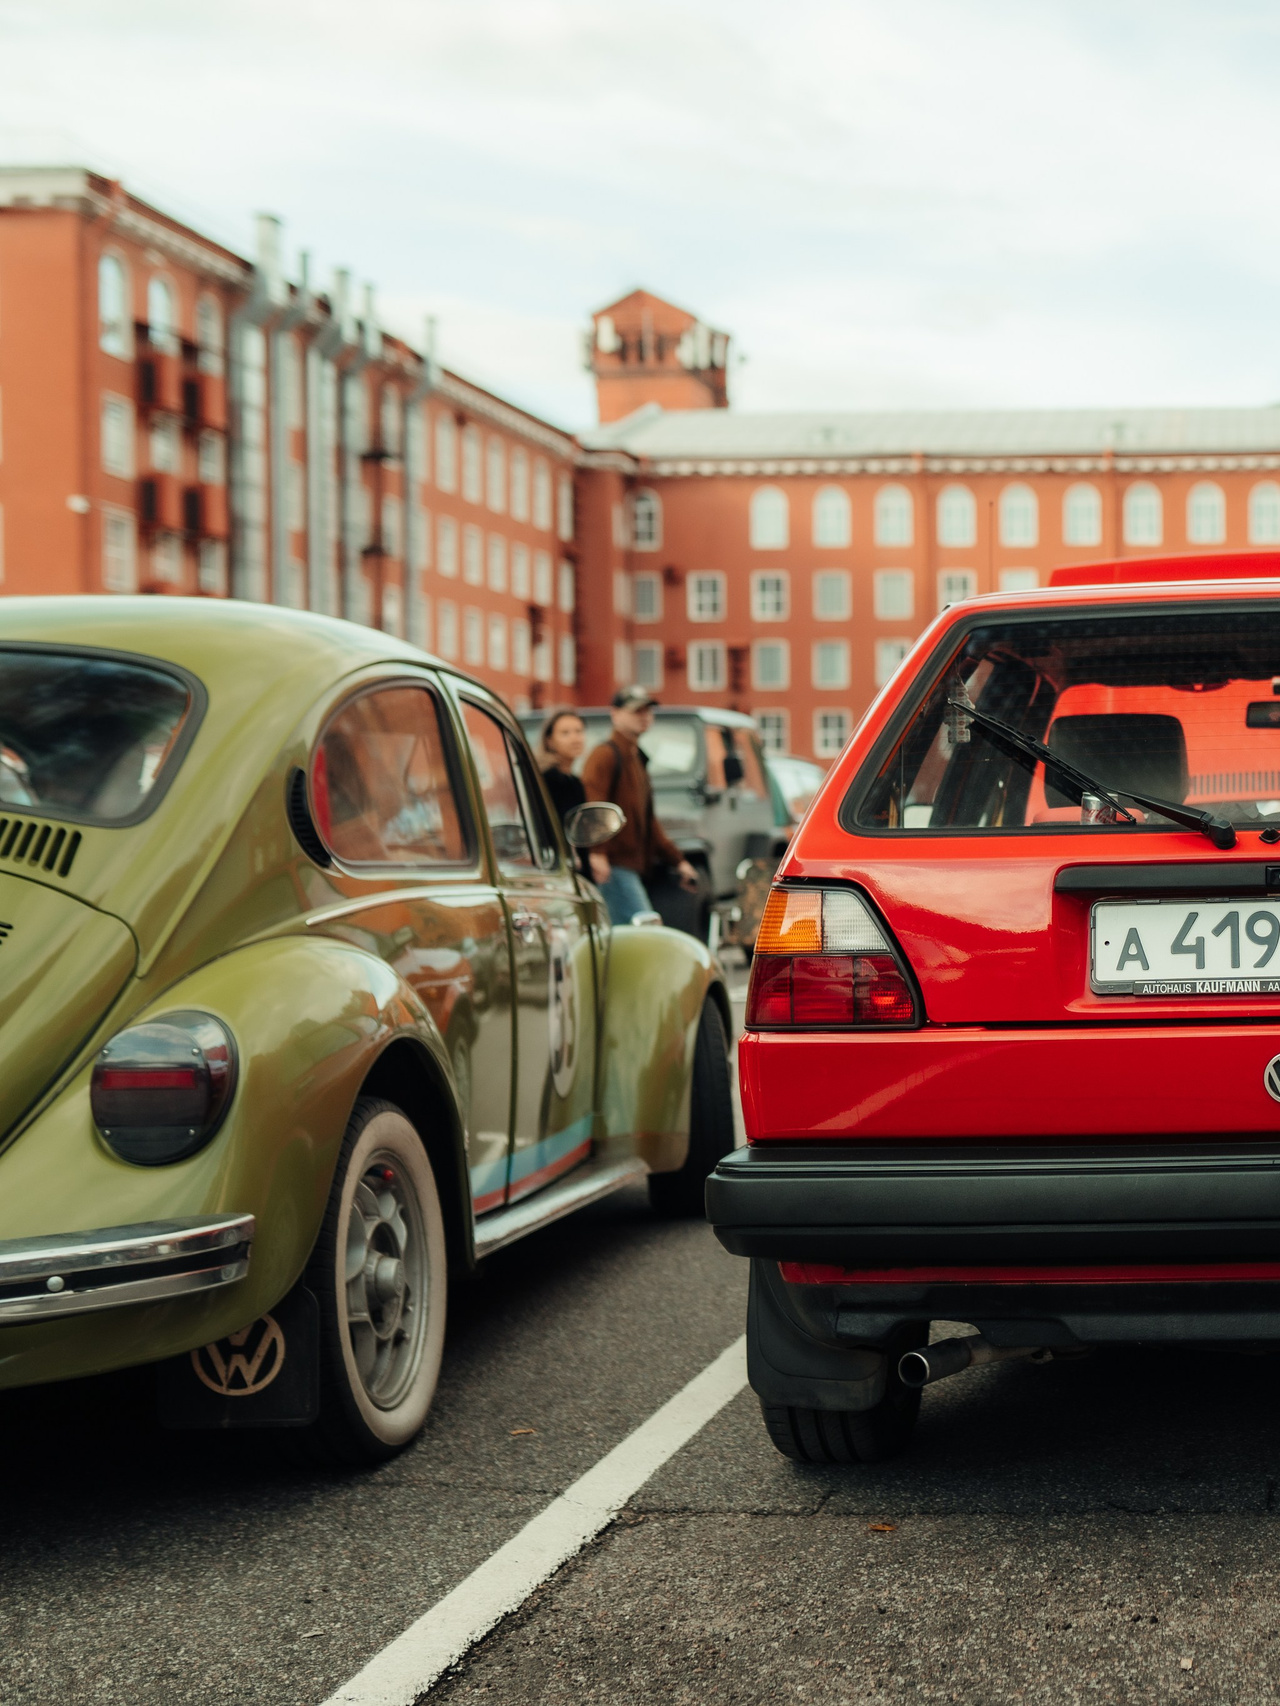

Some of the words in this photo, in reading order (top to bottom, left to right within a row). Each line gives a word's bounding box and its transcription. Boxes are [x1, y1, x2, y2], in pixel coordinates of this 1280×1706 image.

[1170, 910, 1280, 970] 419
[1142, 983, 1192, 994] AUTOHAUS
[1195, 980, 1261, 993] KAUFMANN
